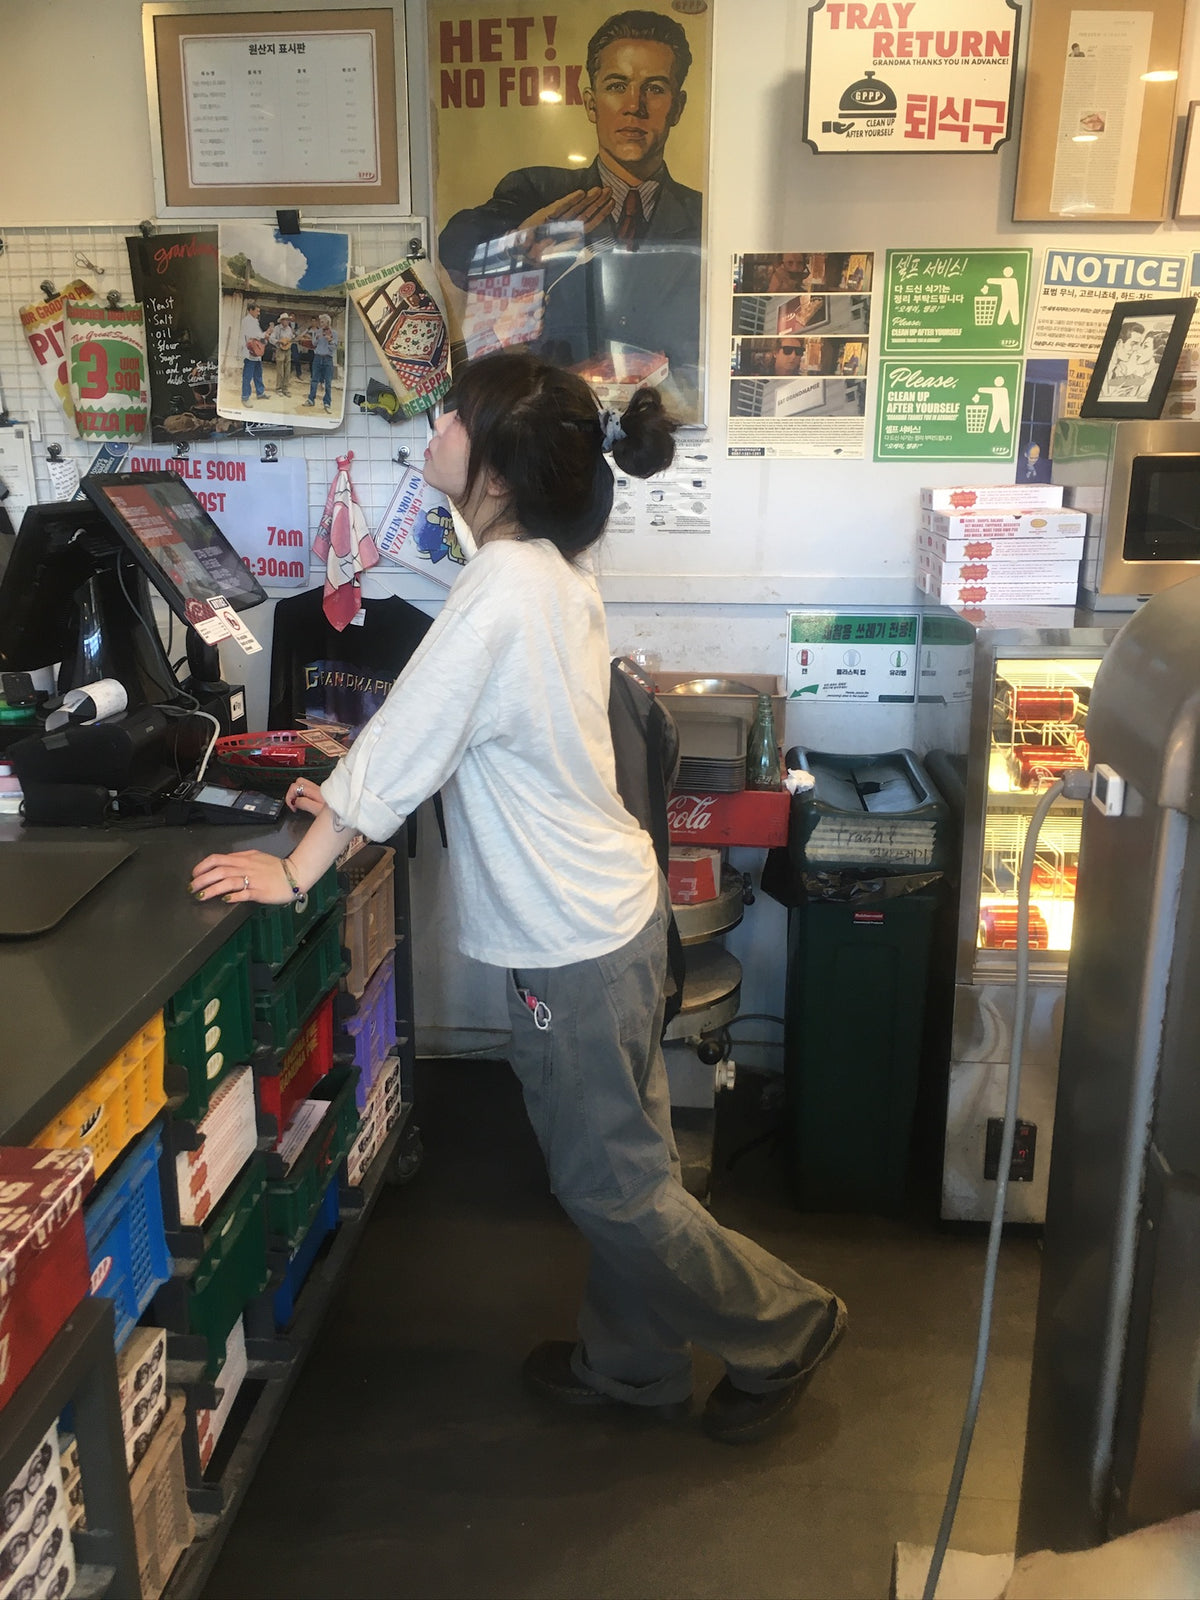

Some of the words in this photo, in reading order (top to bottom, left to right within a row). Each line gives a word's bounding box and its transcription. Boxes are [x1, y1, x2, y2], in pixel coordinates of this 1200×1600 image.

[826, 2, 916, 29] TRAY
[248, 43, 276, 55] 원산지
[279, 43, 306, 55] 표시판
[440, 16, 557, 64] HET!
[872, 31, 1011, 58] RETURN
[440, 68, 485, 109] NO
[499, 65, 584, 107] FORK
[855, 91, 880, 101] GPPP
[866, 119, 886, 127] CLEAN
[887, 118, 895, 126] UP
[904, 93, 1006, 144] 퇴식구
[846, 130, 864, 138] AFTER
[865, 128, 894, 137] YOURSELF
[895, 254, 920, 282] 셀프
[922, 257, 968, 278] 서비스!
[1050, 255, 1180, 288] NOTICE
[894, 285, 903, 293] 다
[905, 284, 922, 293] 드신
[894, 294, 910, 303] 정리
[149, 296, 174, 312] Yeast
[153, 314, 173, 326] Salt
[79, 342, 109, 400] 3
[889, 367, 959, 389] Please,
[887, 391, 916, 402] CLEAN
[917, 391, 930, 402] UP
[887, 402, 914, 413] AFTER
[915, 402, 960, 413] YOURSELF
[75, 411, 119, 432] PIZZA
[206, 460, 246, 481] SOON
[409, 475, 422, 490] NO
[396, 490, 415, 514] FORK
[404, 498, 422, 529] GREAT
[381, 515, 402, 551] NEEDED
[390, 528, 409, 555] PIZZA
[855, 622, 887, 639] 쓰레기
[888, 622, 914, 639] 전용!
